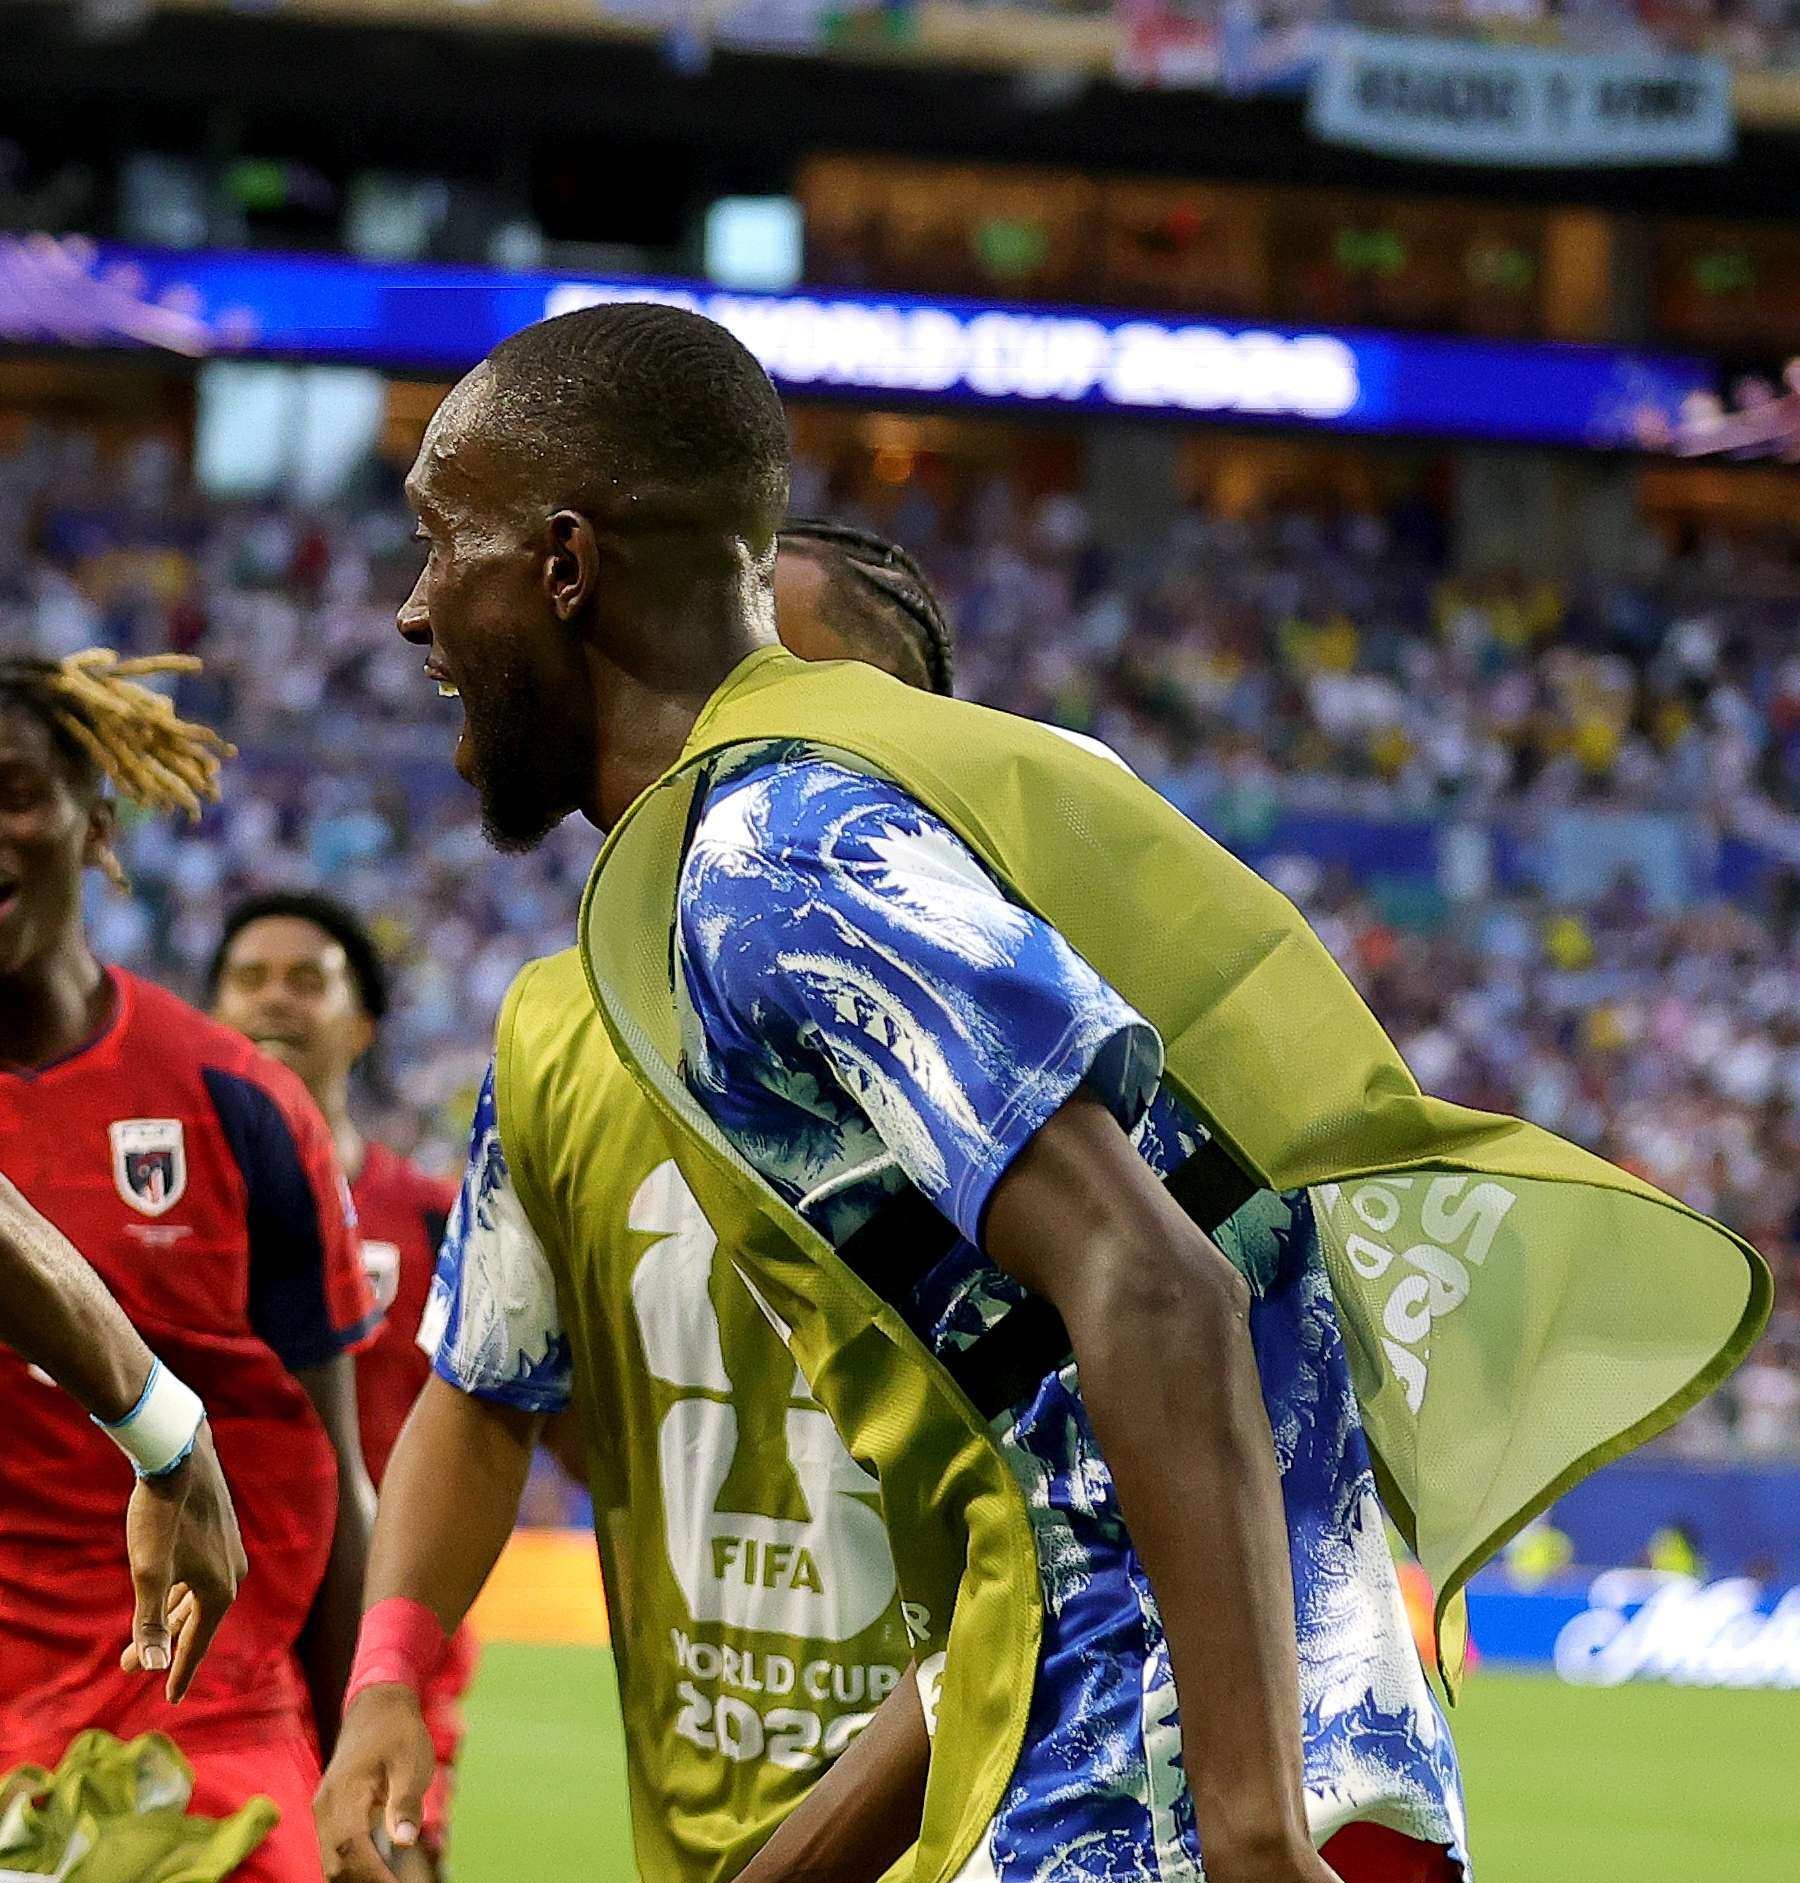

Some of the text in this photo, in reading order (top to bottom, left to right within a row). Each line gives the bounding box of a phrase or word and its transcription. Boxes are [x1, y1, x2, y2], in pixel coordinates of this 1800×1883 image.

[710, 1535, 824, 1594] FIFA
[670, 1627, 901, 1704] WORLD CUP
